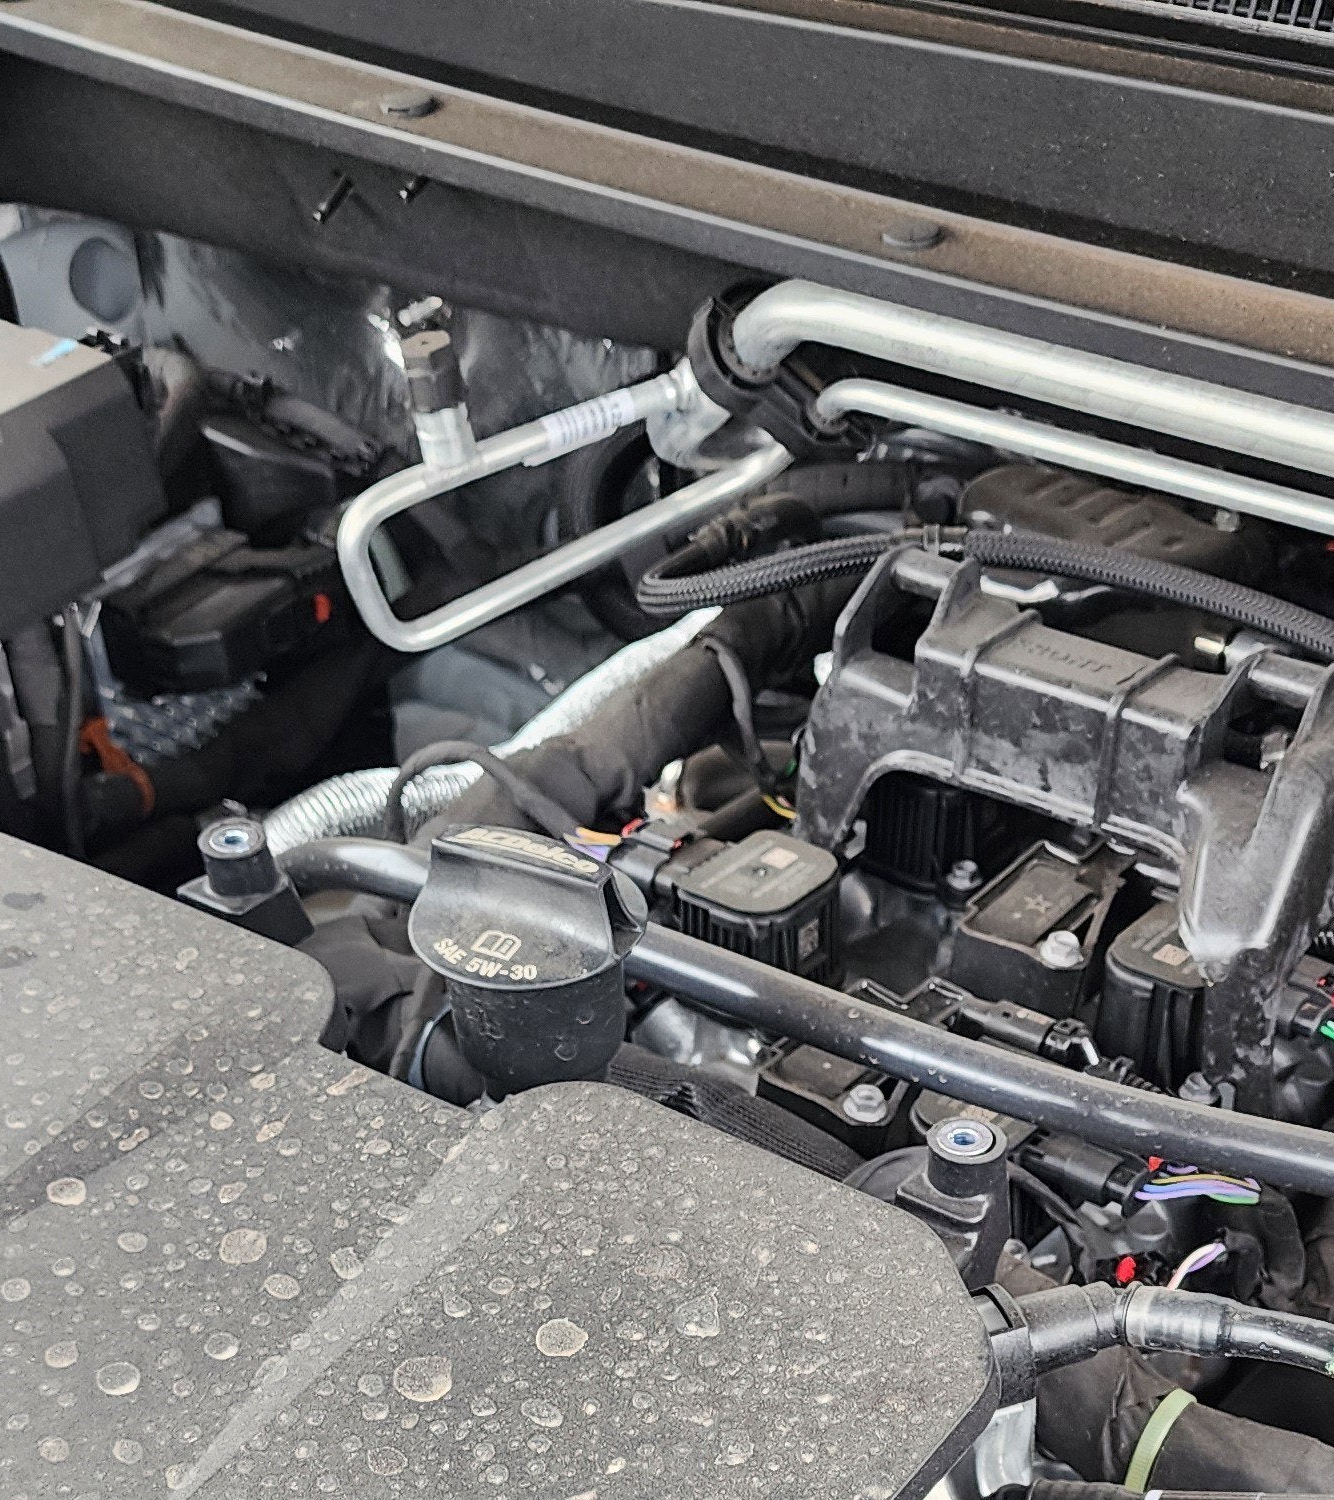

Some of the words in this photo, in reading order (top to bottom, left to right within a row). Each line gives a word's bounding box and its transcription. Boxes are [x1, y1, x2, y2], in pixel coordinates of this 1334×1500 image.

[452, 828, 600, 874] ACDelco
[433, 938, 467, 965] SAE
[465, 957, 538, 981] 5W-30
